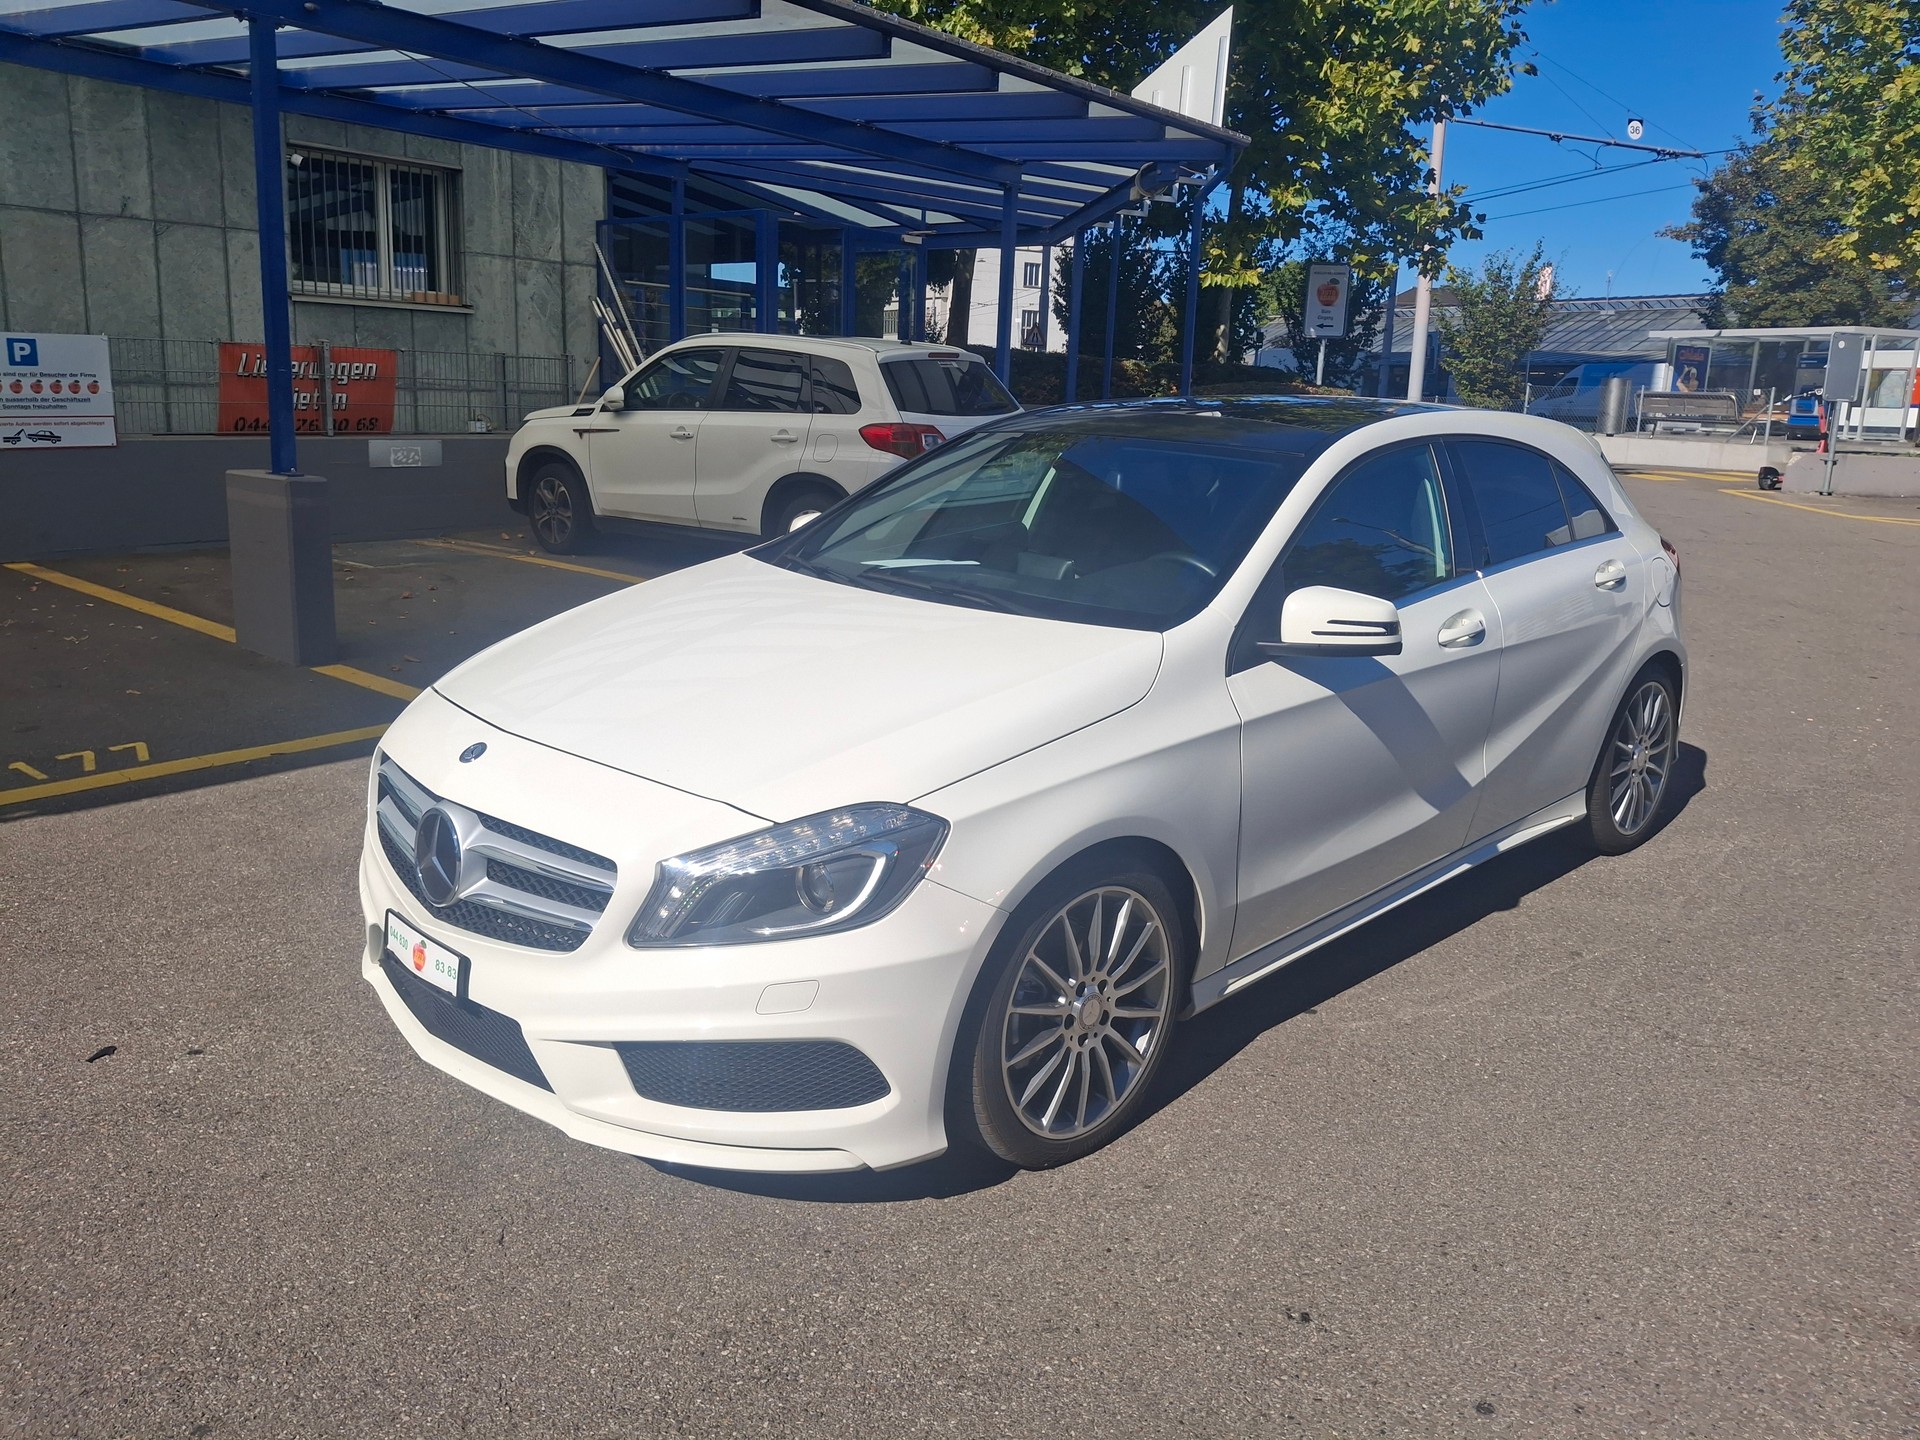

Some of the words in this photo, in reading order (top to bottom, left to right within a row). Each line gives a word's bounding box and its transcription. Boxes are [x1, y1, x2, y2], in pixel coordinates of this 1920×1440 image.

[1629, 125, 1641, 135] 36
[13, 342, 31, 362] P
[237, 352, 377, 385] Lieerwagen
[293, 387, 348, 411] ietn
[389, 925, 399, 941] 044
[435, 959, 445, 974] 83
[447, 965, 457, 980] 83
